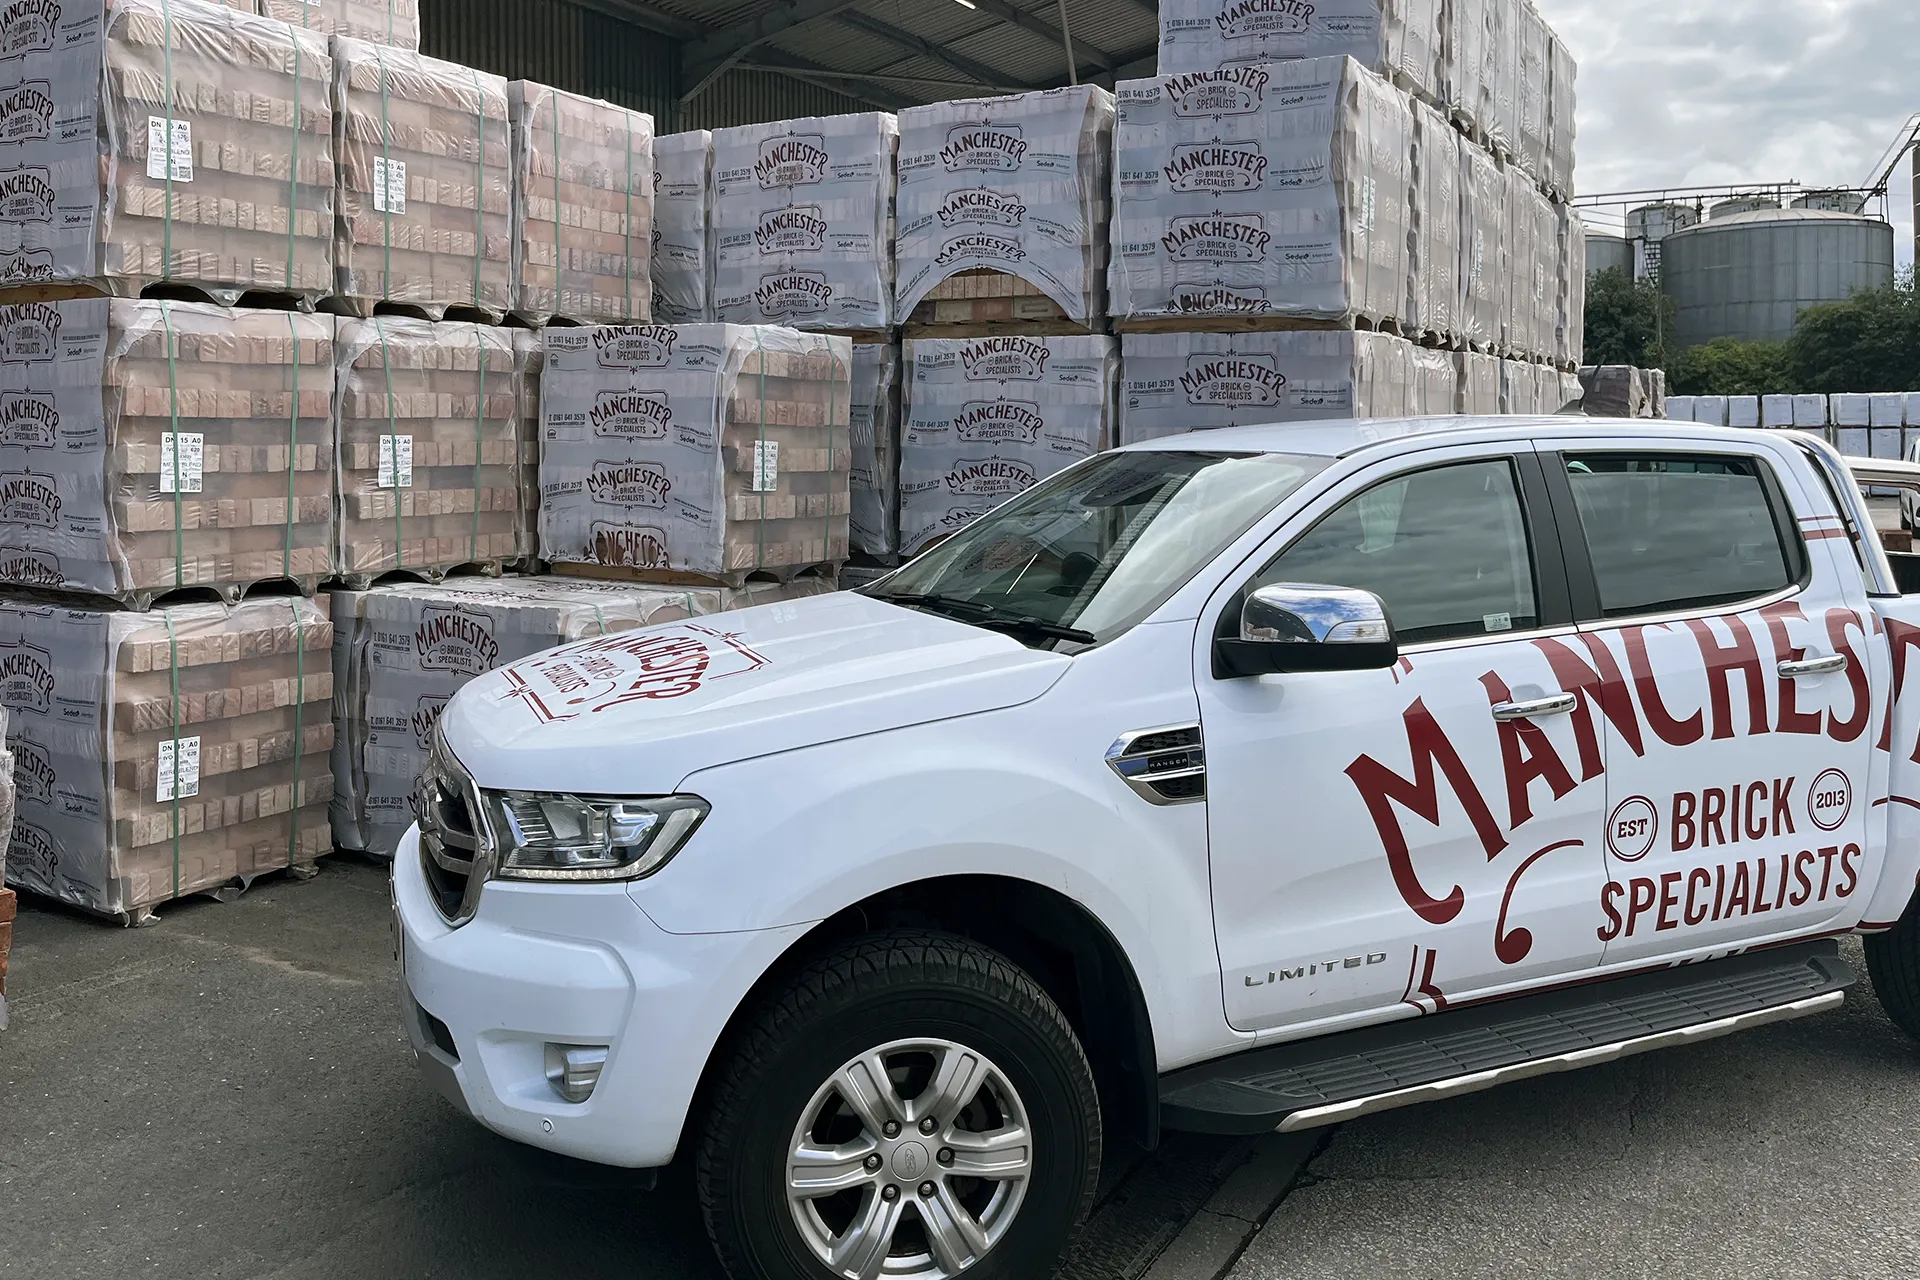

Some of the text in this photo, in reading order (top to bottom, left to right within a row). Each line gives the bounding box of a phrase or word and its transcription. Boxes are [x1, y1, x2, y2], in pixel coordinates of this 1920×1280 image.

[1214, 0, 1315, 31] MANCHESTER
[1254, 15, 1274, 23] BRICK
[1243, 21, 1284, 32] SPECIALISTS
[1164, 67, 1270, 102] MANCHESTER
[1118, 87, 1160, 99] 0161 641 3579
[1208, 87, 1228, 96] BRICK
[1196, 99, 1237, 110] SPECIALISTS
[939, 131, 1028, 165] MANCHESTER
[753, 141, 829, 182] MANCHESTER
[966, 158, 1000, 166] SPECIALISTS
[1163, 148, 1268, 183] MANCHESTER
[1132, 170, 1159, 179] 641 3579
[1205, 170, 1225, 178] BRICK
[1194, 178, 1236, 187] SPECIALISTS
[936, 193, 1027, 223] MANCHESTER
[962, 213, 998, 221] SPECIALISTS
[753, 212, 828, 246] MANCHESTER
[783, 232, 798, 240] BRICK
[1160, 221, 1272, 255] MANCHESTER
[775, 239, 805, 248] SPECIALISTS
[1129, 242, 1156, 252] 641 3579
[1206, 241, 1228, 250] BRICK
[934, 236, 1027, 264] MANCHESTER
[1195, 249, 1238, 258] SPECIALISTS
[753, 276, 833, 306] MANCHESTER
[776, 299, 809, 308] SPECIALISTS
[553, 336, 588, 345] 0161 641 3579
[591, 325, 679, 356] MANCHESTER
[625, 340, 643, 349] BRICK
[616, 349, 650, 361] SPECIALISTS
[922, 353, 955, 363] 0161 641 3579
[959, 337, 1051, 373] MANCHESTER
[994, 355, 1013, 364] BRICK
[985, 366, 1022, 375] SPECIALISTS
[1134, 379, 1175, 389] 0161 641 3579
[1178, 361, 1287, 398] MANCHESTER
[1220, 382, 1242, 391] BRICK
[1209, 391, 1252, 401] SPECIALISTS
[553, 413, 586, 421] 0161 641 3579
[588, 396, 673, 432] MANCHESTER
[622, 417, 638, 425] BRICK
[953, 405, 1044, 440] MANCHESTER
[988, 422, 1006, 430] BRICK
[614, 425, 647, 434] SPECIALISTS
[978, 430, 1015, 438] SPECIALISTS
[550, 481, 583, 492] 0161 641 3579
[586, 467, 672, 504] MANCHESTER
[619, 486, 637, 494] BRICK
[972, 485, 1011, 493] SPECIALISTS
[610, 494, 645, 502] SPECIALISTS
[377, 632, 411, 645] 0161 641 3579
[415, 615, 499, 671] MANCHESTER
[446, 645, 464, 656] BRICK
[438, 656, 472, 667] SPECIALISTS
[375, 716, 408, 727] 0161 641 3579
[1149, 758, 1187, 768] RANGER
[1343, 598, 1920, 925] MANCHEST
[1617, 776, 1846, 853] EST BRICK 2013
[1596, 842, 1862, 942] SPECIALISTS
[1244, 951, 1387, 987] LIMITED
